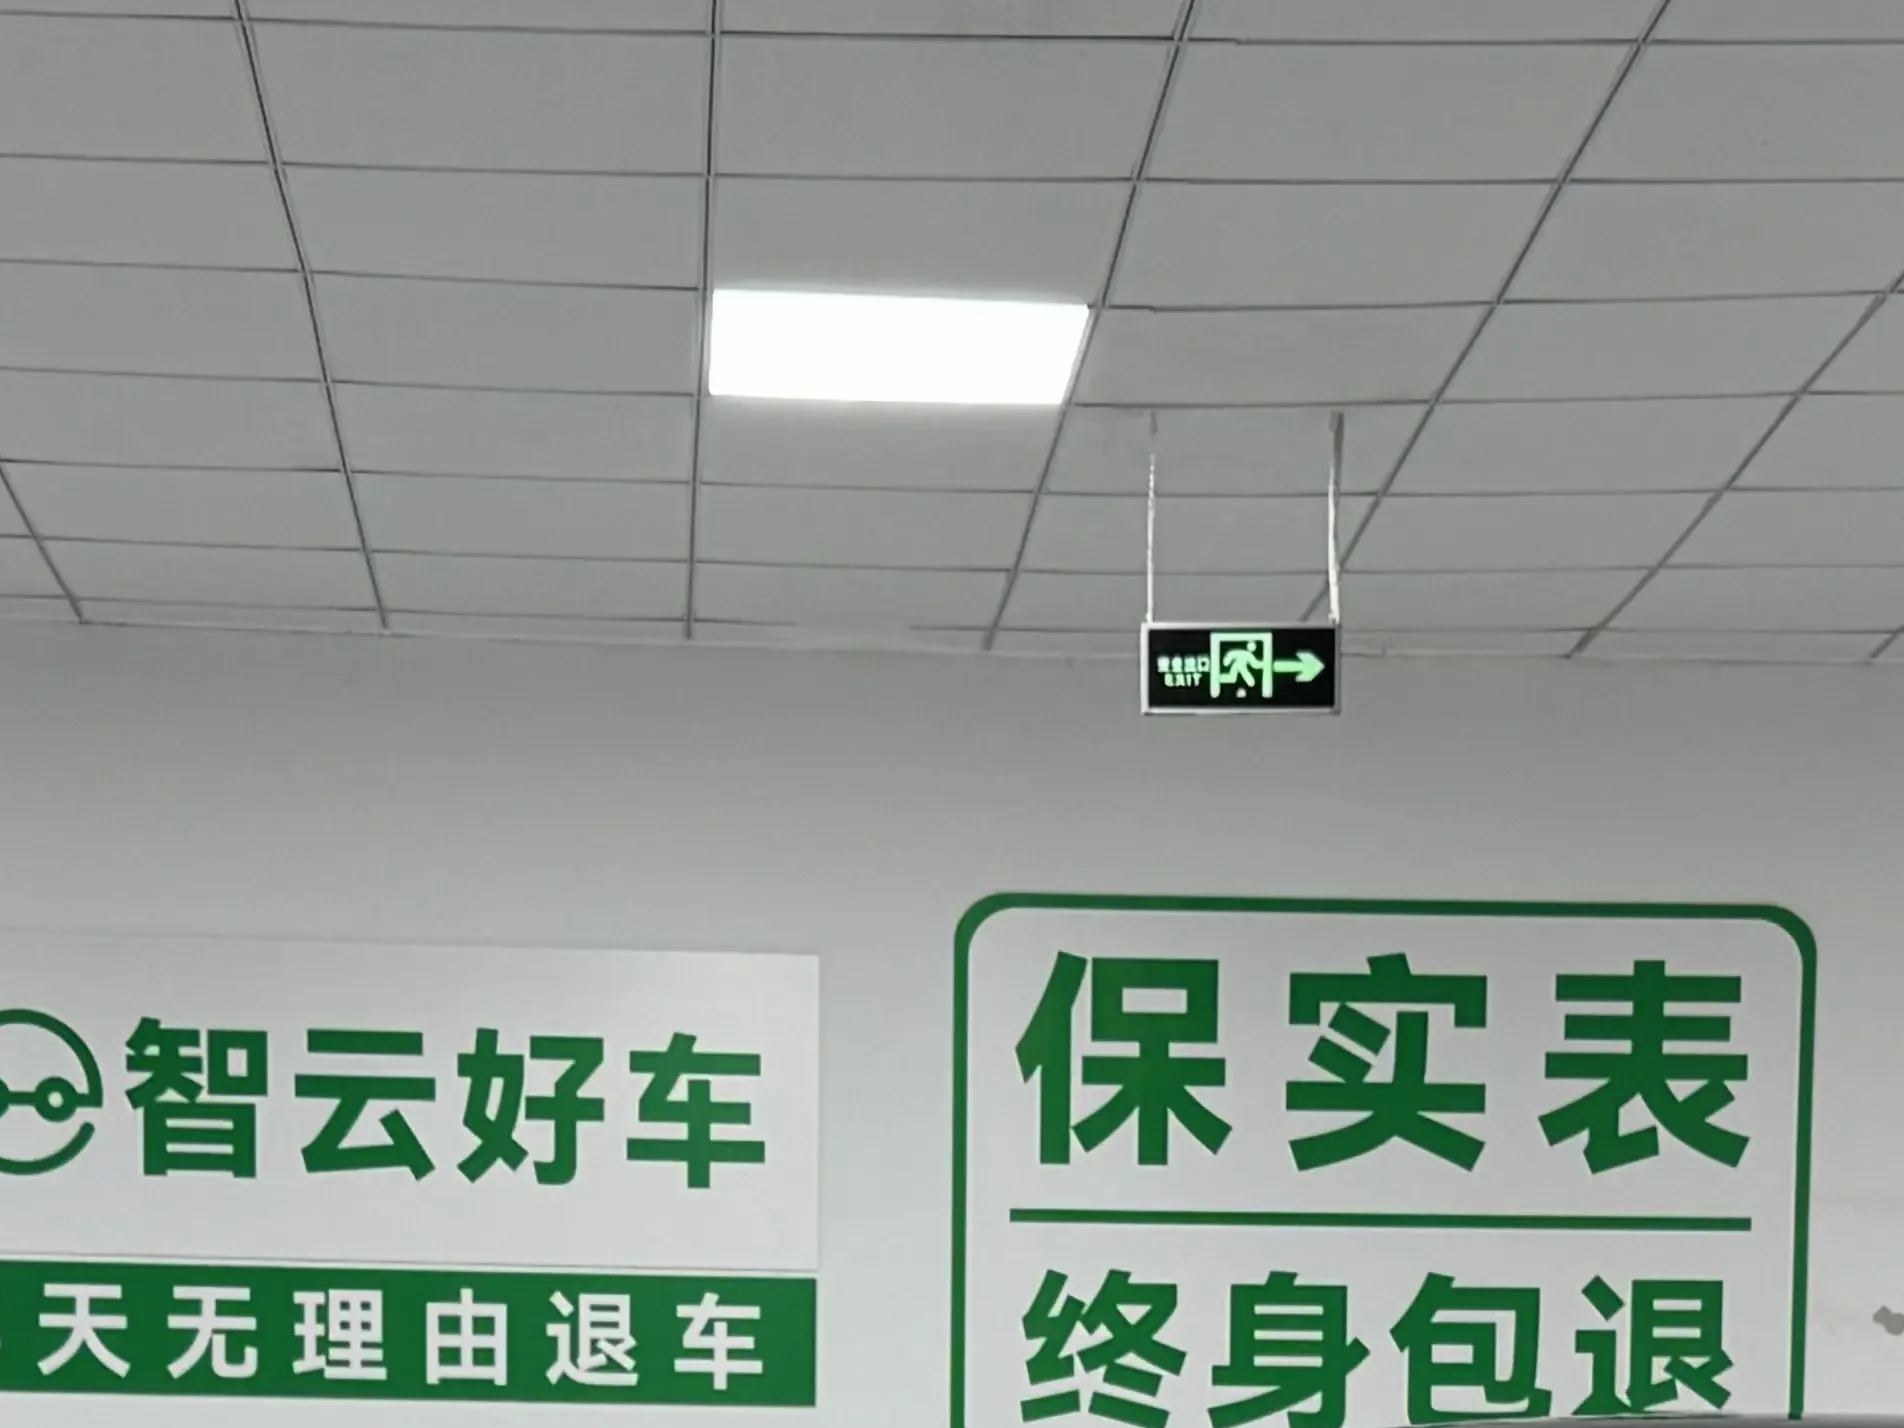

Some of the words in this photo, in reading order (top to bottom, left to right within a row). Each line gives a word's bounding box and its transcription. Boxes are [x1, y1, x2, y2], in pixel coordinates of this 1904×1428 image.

[125, 1016, 766, 1189] 智云好车
[1016, 952, 1749, 1174] 保实表
